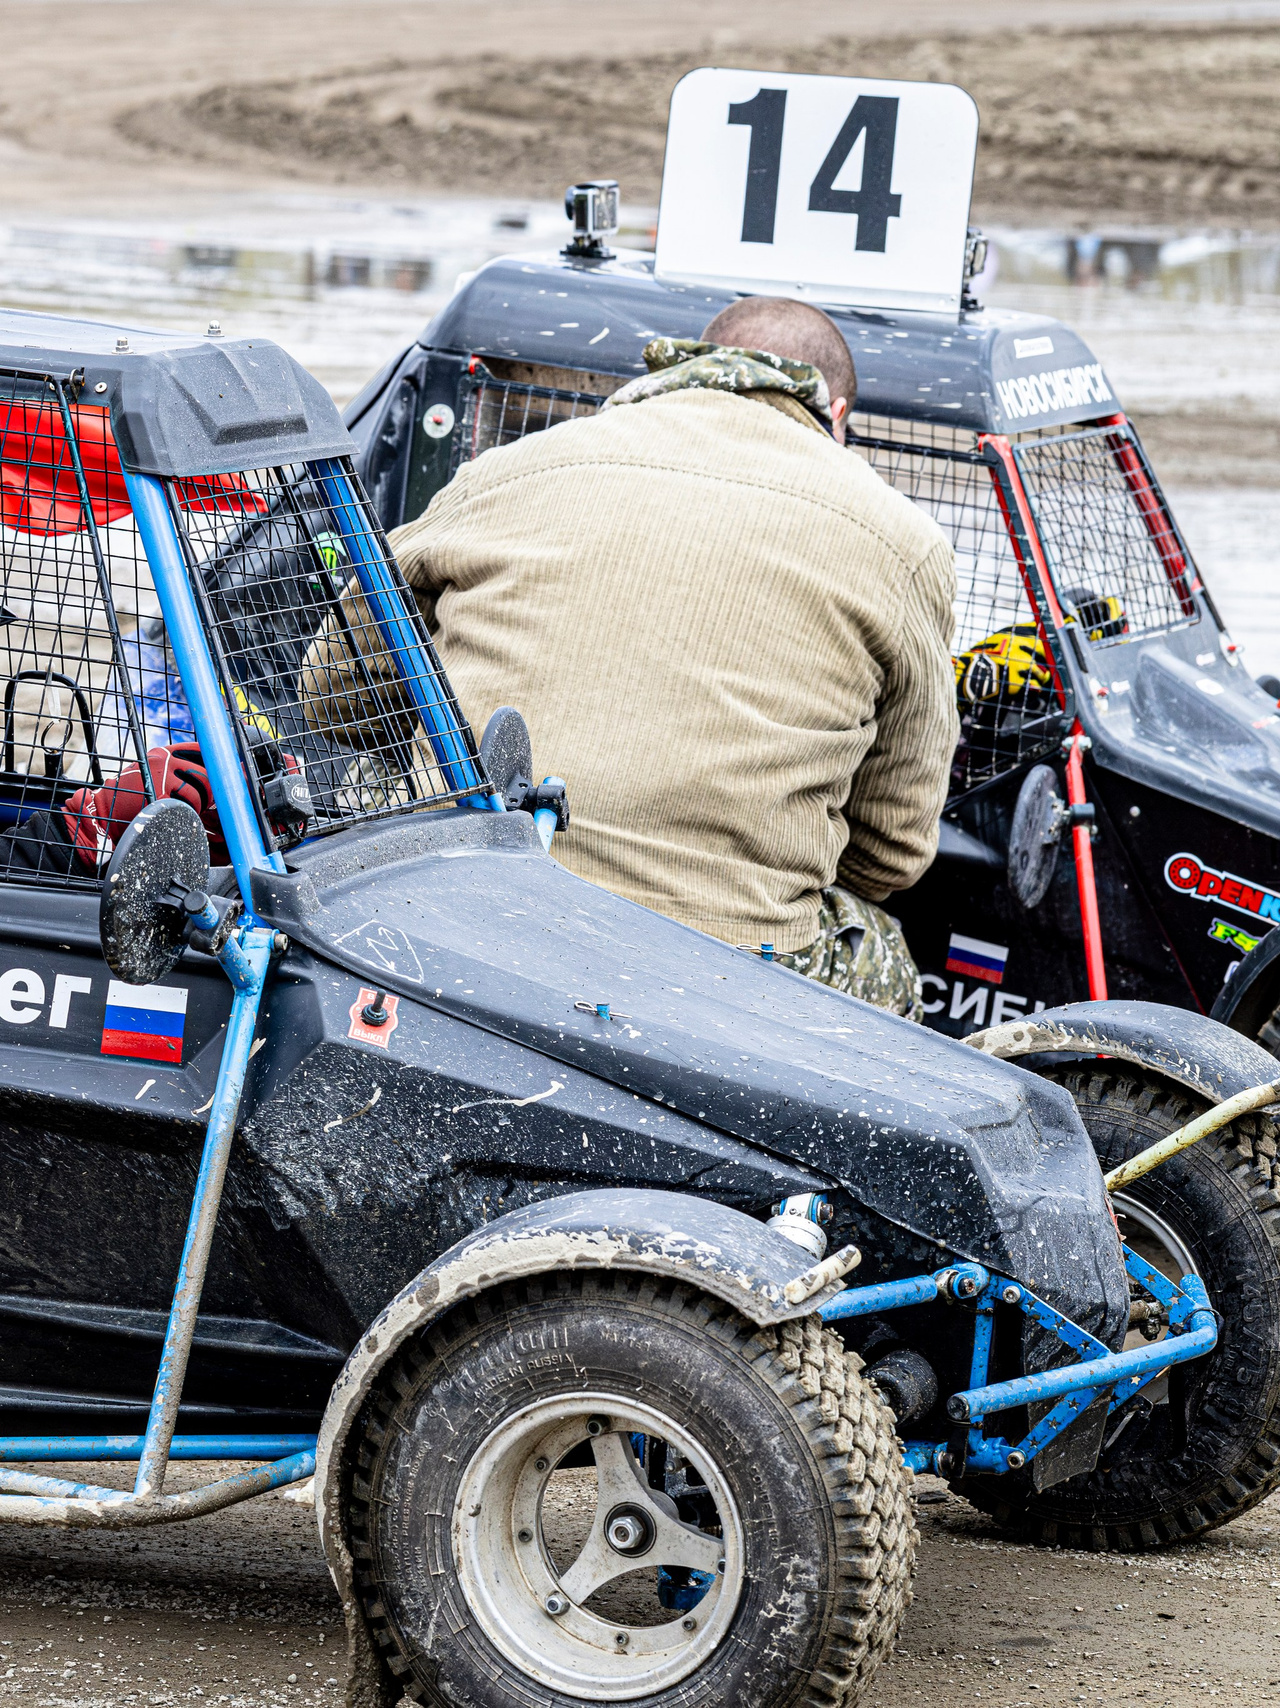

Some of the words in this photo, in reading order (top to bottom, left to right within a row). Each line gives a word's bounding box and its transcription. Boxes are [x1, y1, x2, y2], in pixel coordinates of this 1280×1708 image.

[727, 88, 902, 253] 14
[995, 363, 1113, 420] НОВОСИБИРСК
[920, 973, 1046, 1027] СИБ
